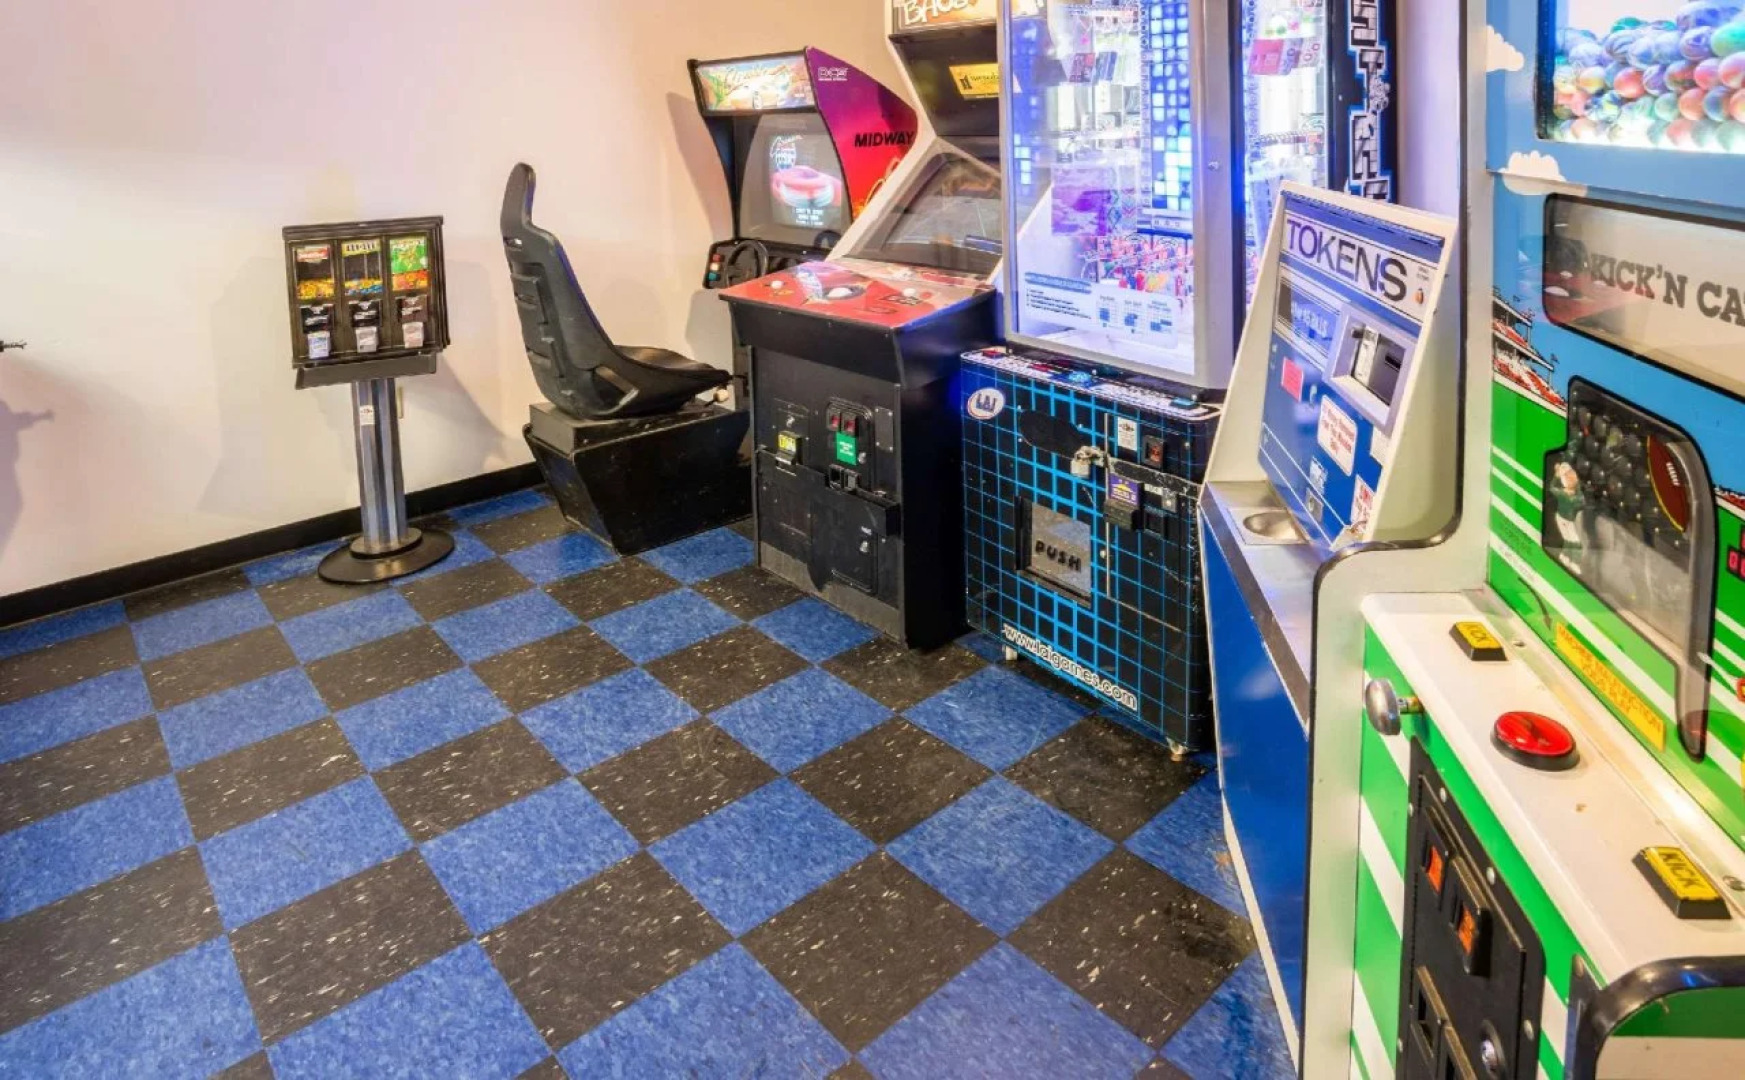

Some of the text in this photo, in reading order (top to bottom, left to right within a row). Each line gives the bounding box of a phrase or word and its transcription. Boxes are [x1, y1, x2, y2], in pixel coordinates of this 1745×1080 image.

[1350, 0, 1391, 199] STA
[854, 130, 915, 148] MIDWAY
[1286, 219, 1407, 302] TOKENS
[1590, 253, 1745, 328] KICK'N CA
[1034, 539, 1082, 573] PUSH
[1001, 622, 1139, 712] www.laigames.com
[1658, 850, 1707, 889] KICK
